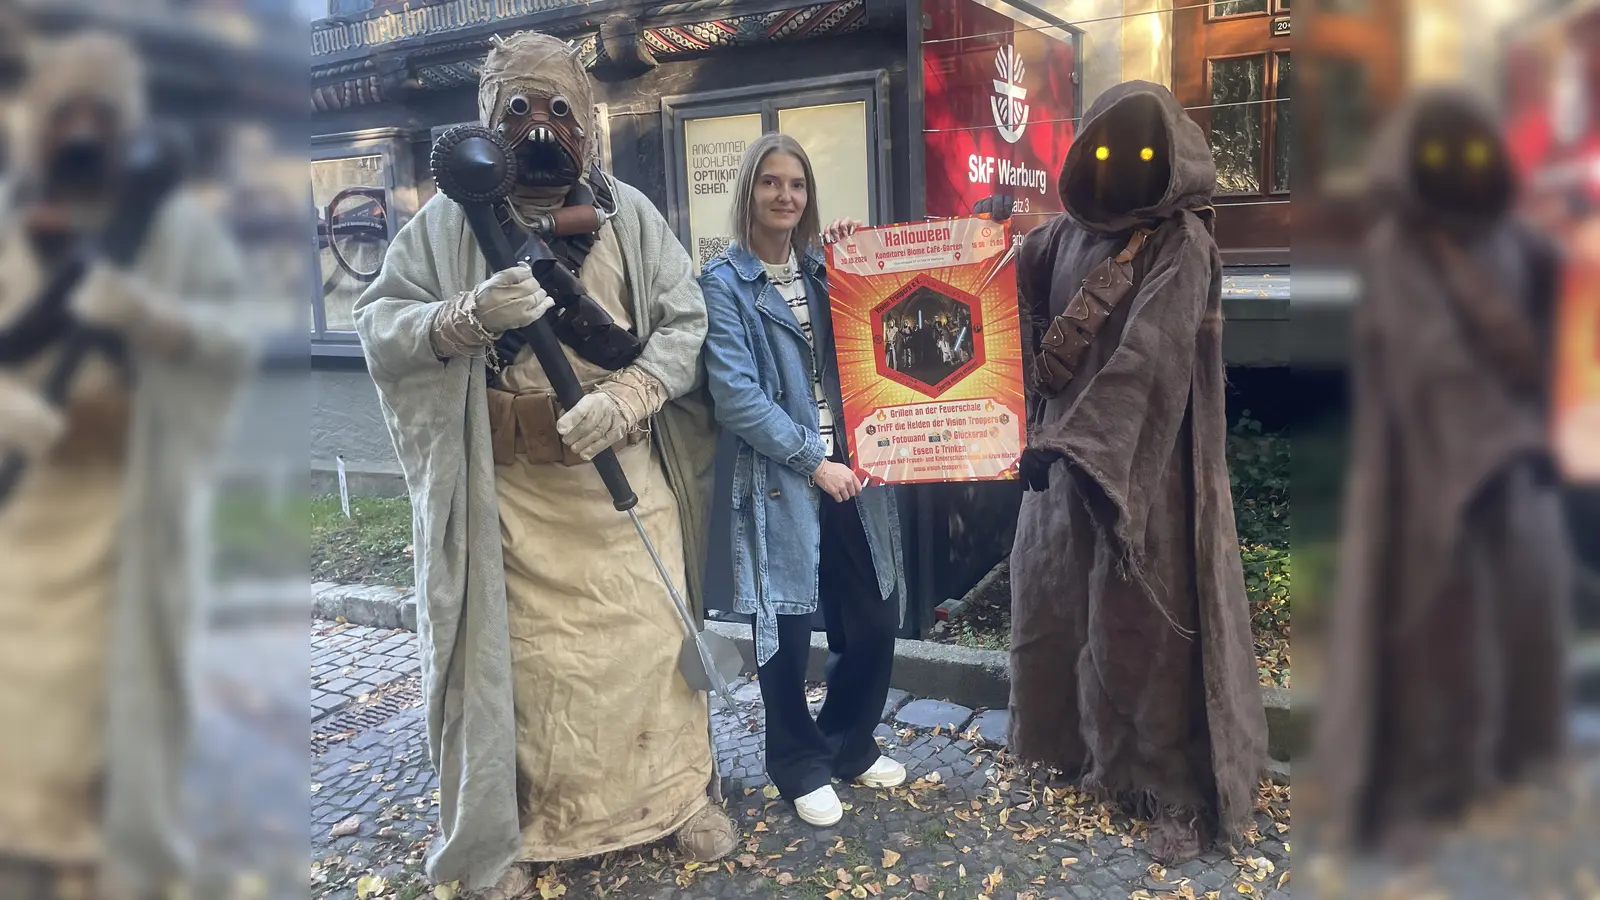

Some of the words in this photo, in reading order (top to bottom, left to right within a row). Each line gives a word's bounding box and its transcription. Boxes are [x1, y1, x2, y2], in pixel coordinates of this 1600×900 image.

[692, 140, 746, 155] ANKOMMEN
[692, 153, 741, 169] WOHLFÜH
[693, 168, 739, 182] OPTI(K)M
[968, 153, 995, 184] SkF
[997, 158, 1047, 195] Warburg
[694, 182, 729, 195] SEHEN.
[1011, 199, 1024, 213] atz
[1024, 197, 1030, 213] 3
[884, 227, 951, 247] Halloween
[1011, 230, 1026, 246] arb
[875, 250, 906, 260] Konditorei
[890, 409, 913, 418] Grillen
[925, 406, 937, 415] der
[939, 403, 981, 413] Feuerschale
[895, 422, 906, 431] die
[907, 420, 931, 430] Helden
[932, 419, 944, 427] der
[945, 417, 967, 427] Vision
[968, 416, 999, 426] Troopers
[892, 433, 926, 444] Fotowand
[912, 446, 934, 456] Essen
[941, 444, 967, 454] Trinken
